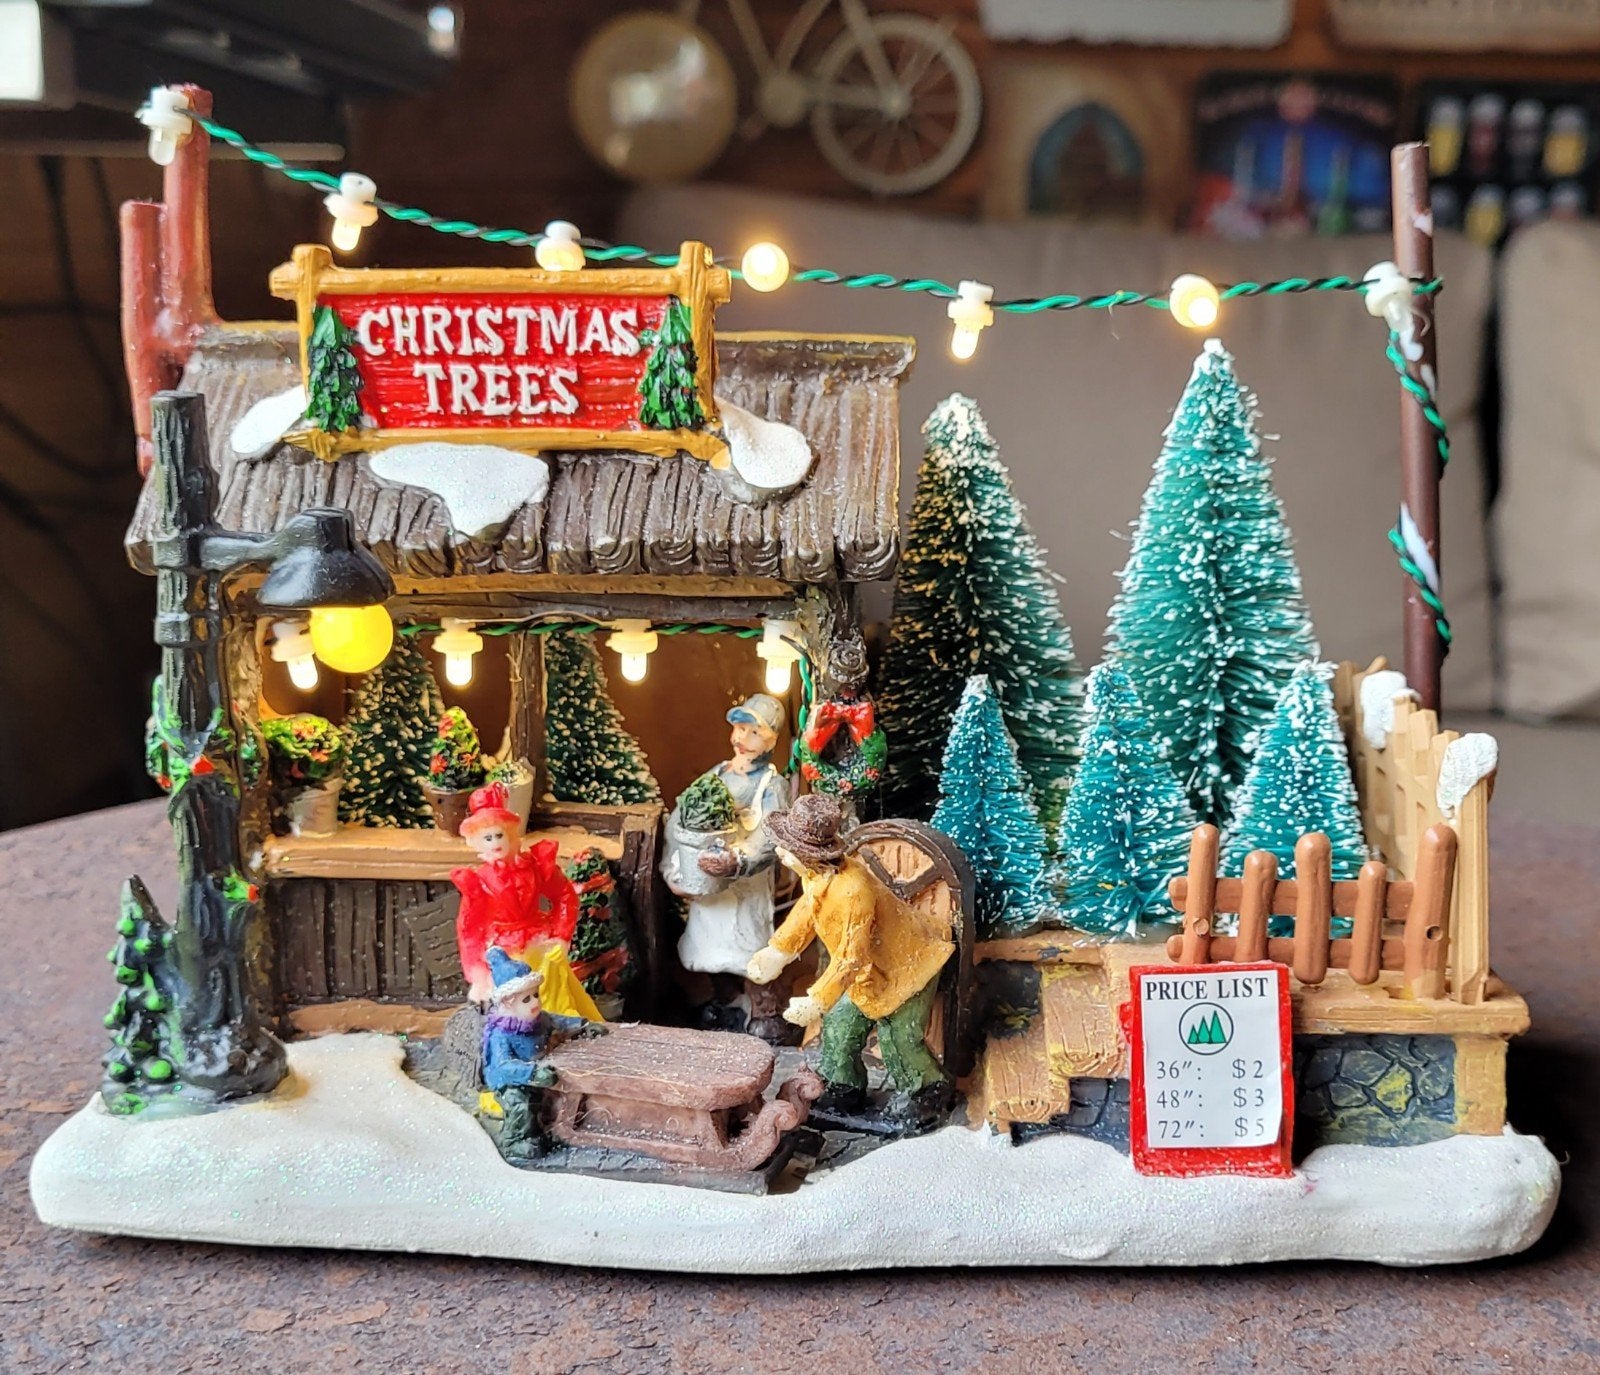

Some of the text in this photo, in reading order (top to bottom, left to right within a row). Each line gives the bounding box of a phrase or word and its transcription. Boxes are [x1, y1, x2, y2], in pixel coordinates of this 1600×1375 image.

[357, 305, 642, 357] CHRISTMAS
[413, 362, 580, 416] TREES
[1145, 977, 1269, 1001] PRICE LIST
